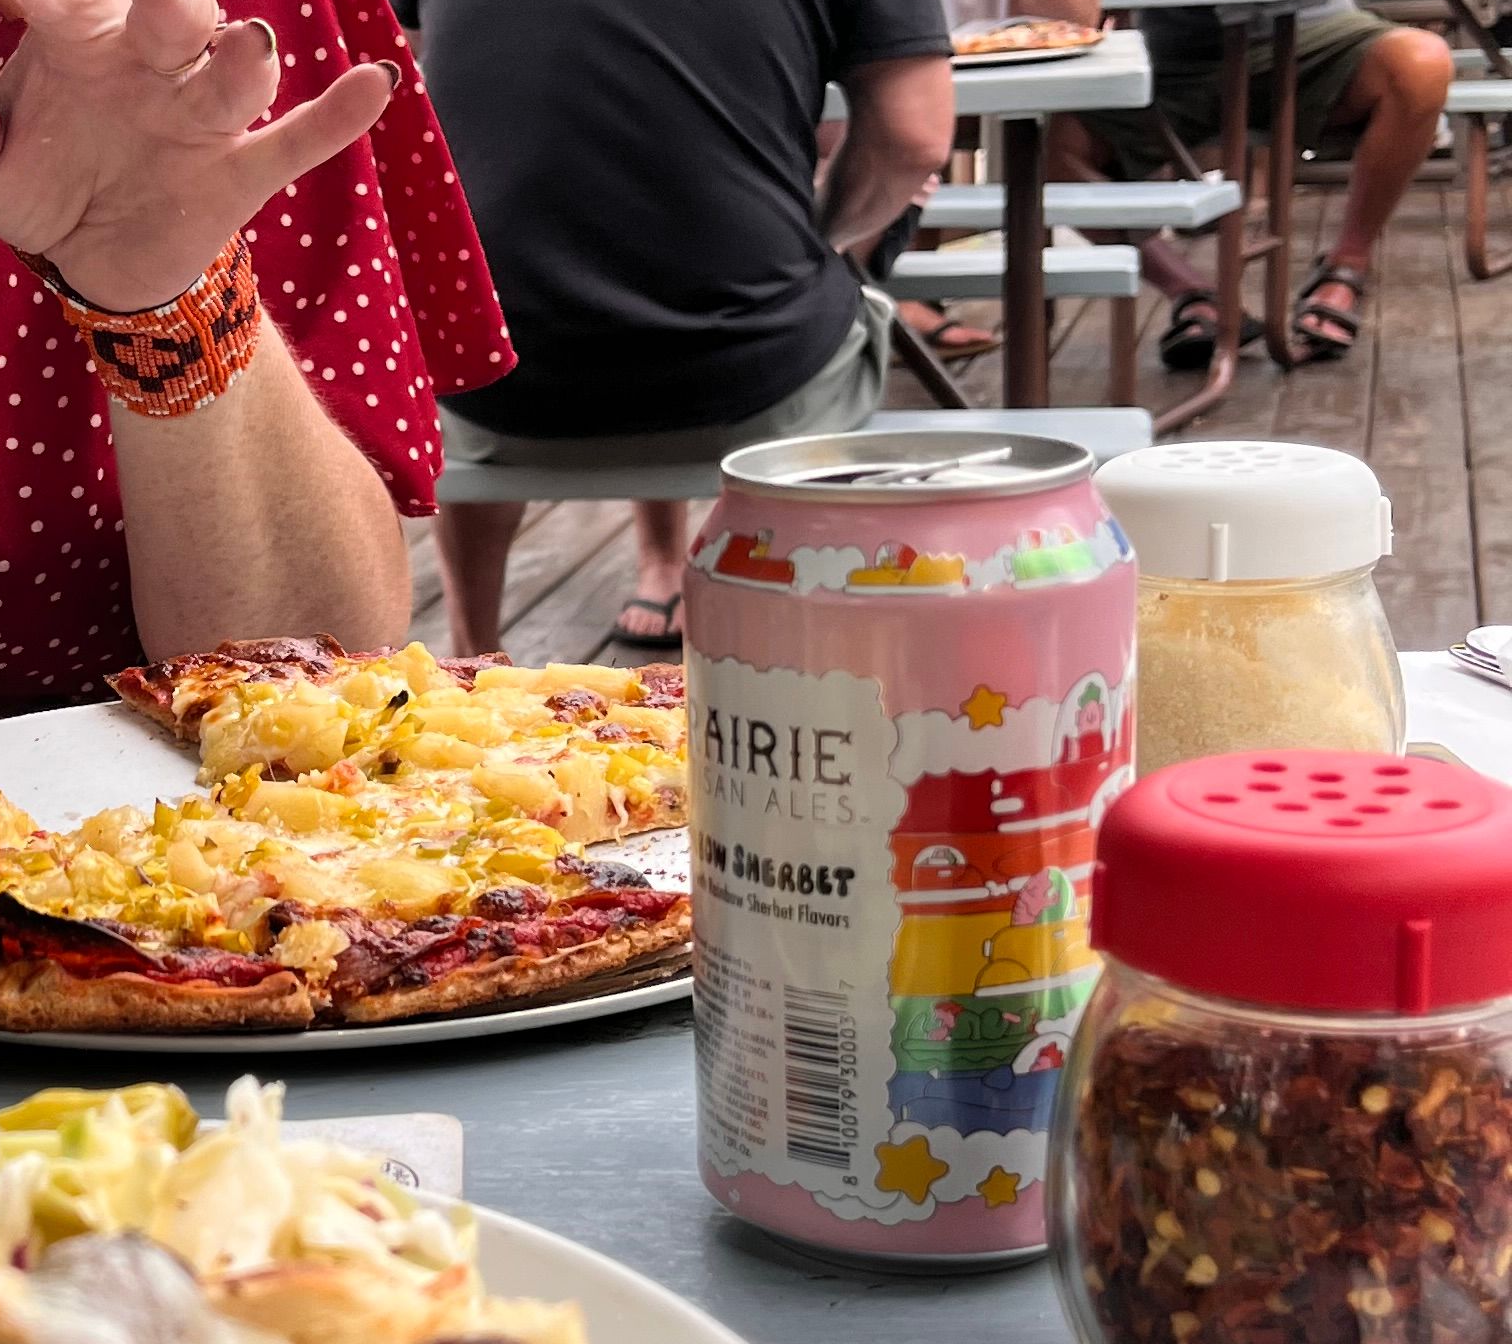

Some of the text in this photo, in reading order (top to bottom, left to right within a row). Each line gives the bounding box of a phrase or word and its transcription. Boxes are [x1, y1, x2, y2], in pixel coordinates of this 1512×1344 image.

[703, 706, 852, 787] AIRIE
[797, 904, 851, 930] Flavors
[839, 1015, 857, 1080] 30003
[840, 1087, 859, 1148] 10079
[842, 1175, 858, 1186] 8
